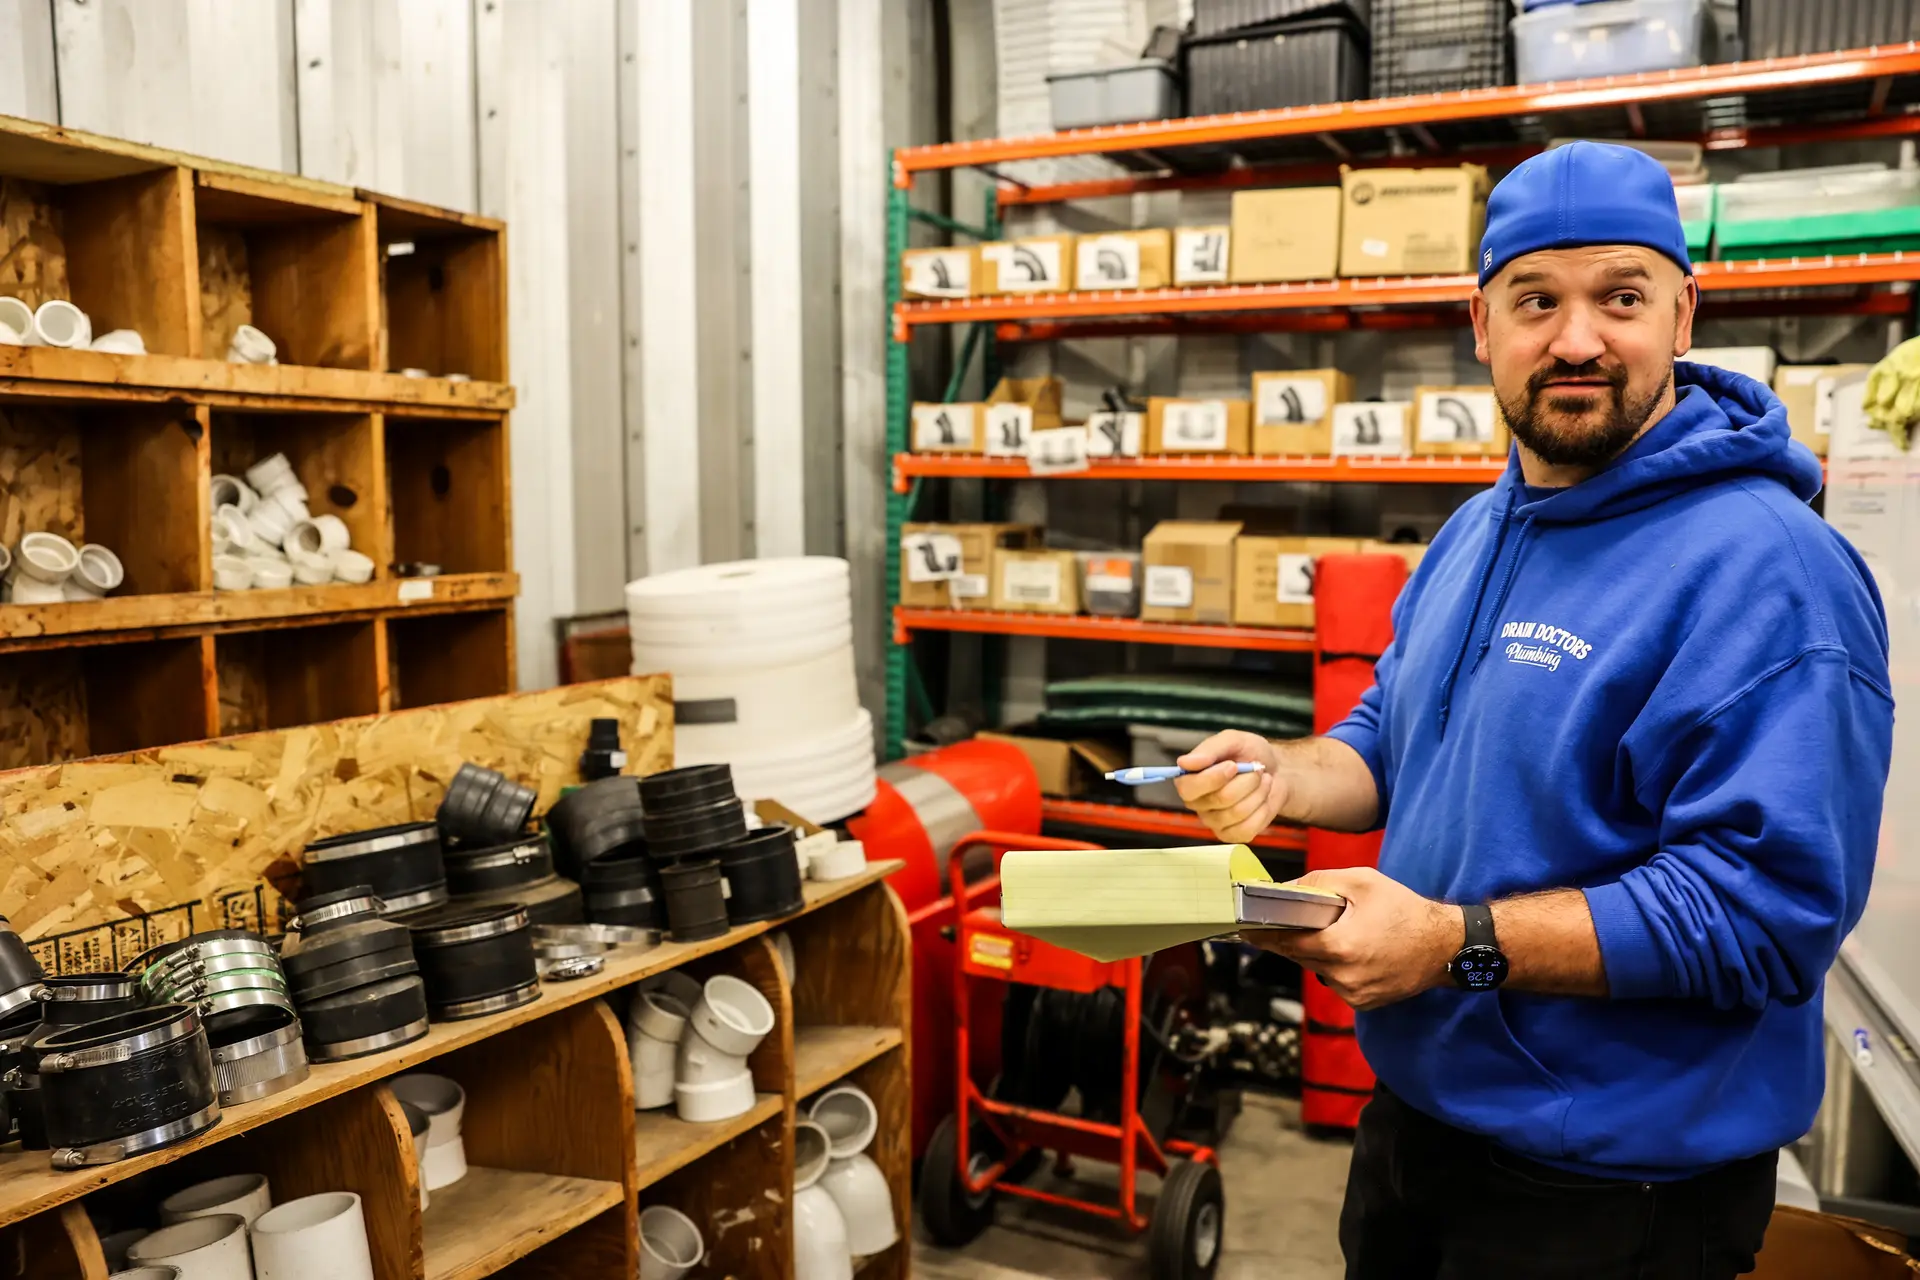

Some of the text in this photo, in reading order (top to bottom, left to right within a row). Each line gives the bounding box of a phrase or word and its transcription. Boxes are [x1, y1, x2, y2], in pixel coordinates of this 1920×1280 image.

[1501, 622, 1593, 660] DRAIN DOCTORS
[1505, 642, 1562, 671] Plumbing
[1467, 971, 1494, 981] 8:28
